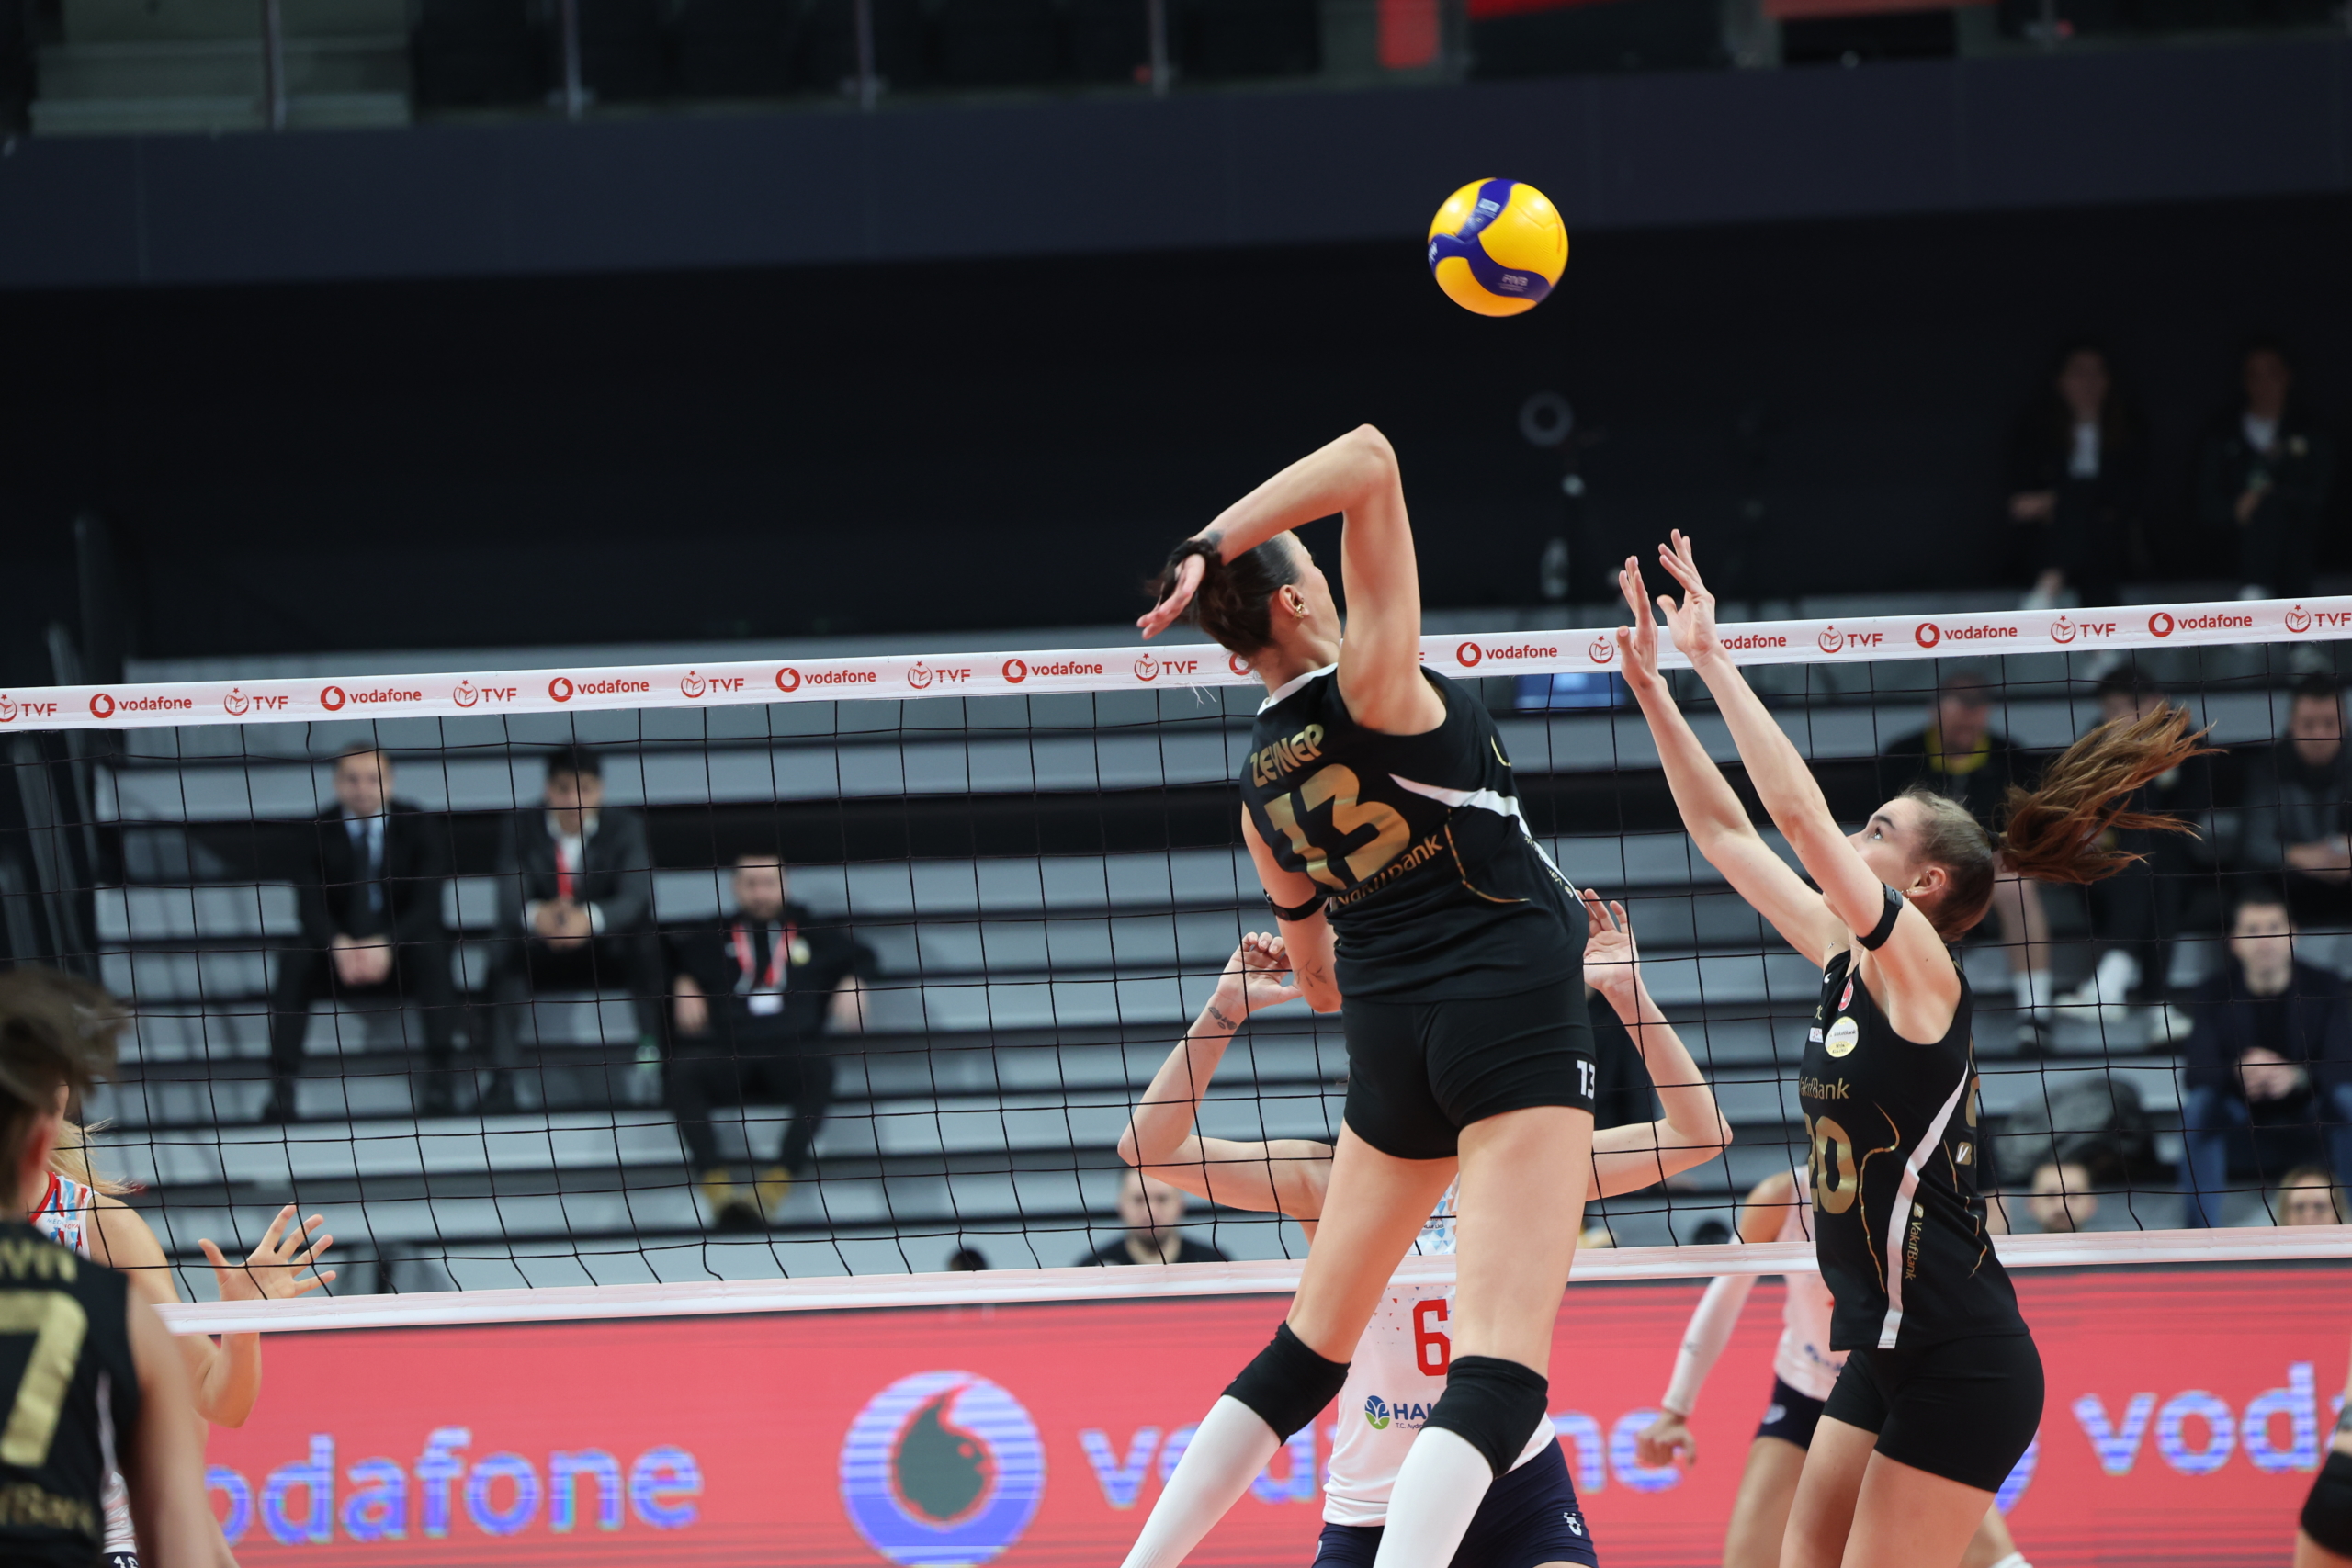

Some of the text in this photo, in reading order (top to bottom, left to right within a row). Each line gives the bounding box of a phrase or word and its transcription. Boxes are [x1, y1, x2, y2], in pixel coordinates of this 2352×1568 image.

[21, 703, 58, 717] TVF
[119, 695, 193, 711] vodafone
[253, 695, 289, 710] TVF
[349, 688, 423, 704] vodafone
[481, 687, 517, 702] TVF
[577, 679, 650, 694] vodafone
[708, 677, 745, 693] TVF
[804, 669, 877, 685] vodafone
[935, 668, 972, 683] TVF
[1030, 660, 1103, 676] vodafone
[1162, 660, 1199, 674] TVF
[1486, 644, 1558, 660] vodafone
[1847, 632, 1883, 647] TVF
[1944, 625, 2018, 640] vodafone
[2080, 622, 2117, 637] TVF
[2177, 613, 2254, 629] vodafone
[2314, 612, 2352, 627] TVF
[1250, 723, 1324, 788] ZEYNEP
[1264, 763, 1411, 892] 13
[1577, 1059, 1596, 1100] 13
[1412, 1298, 1452, 1377] 6
[2072, 1360, 2346, 1476] vod
[204, 1426, 705, 1546] odafone
